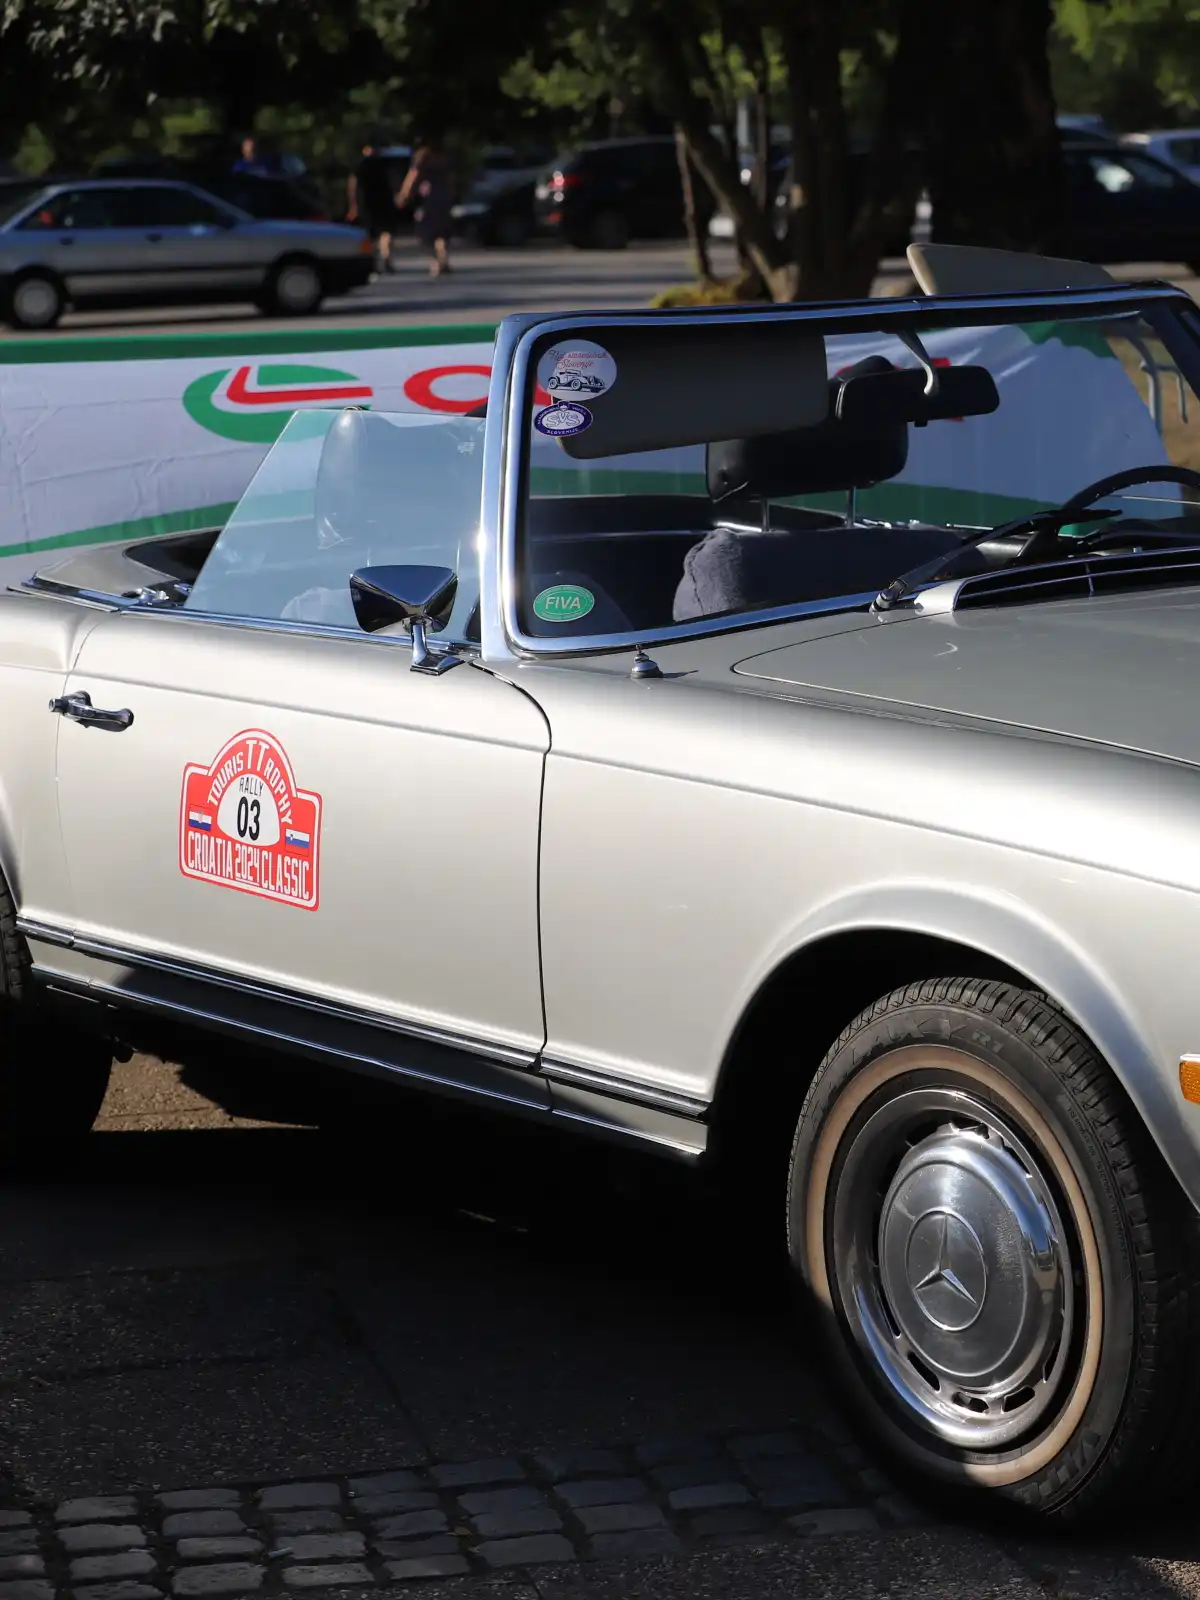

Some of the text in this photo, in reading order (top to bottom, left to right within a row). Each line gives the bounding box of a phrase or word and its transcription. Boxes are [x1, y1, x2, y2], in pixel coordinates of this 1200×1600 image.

[546, 411, 580, 427] SVS
[545, 596, 581, 609] FIVA
[239, 777, 264, 796] RALLY
[237, 796, 261, 841] 03
[187, 831, 310, 899] CROATIA 2024 CLASSIC
